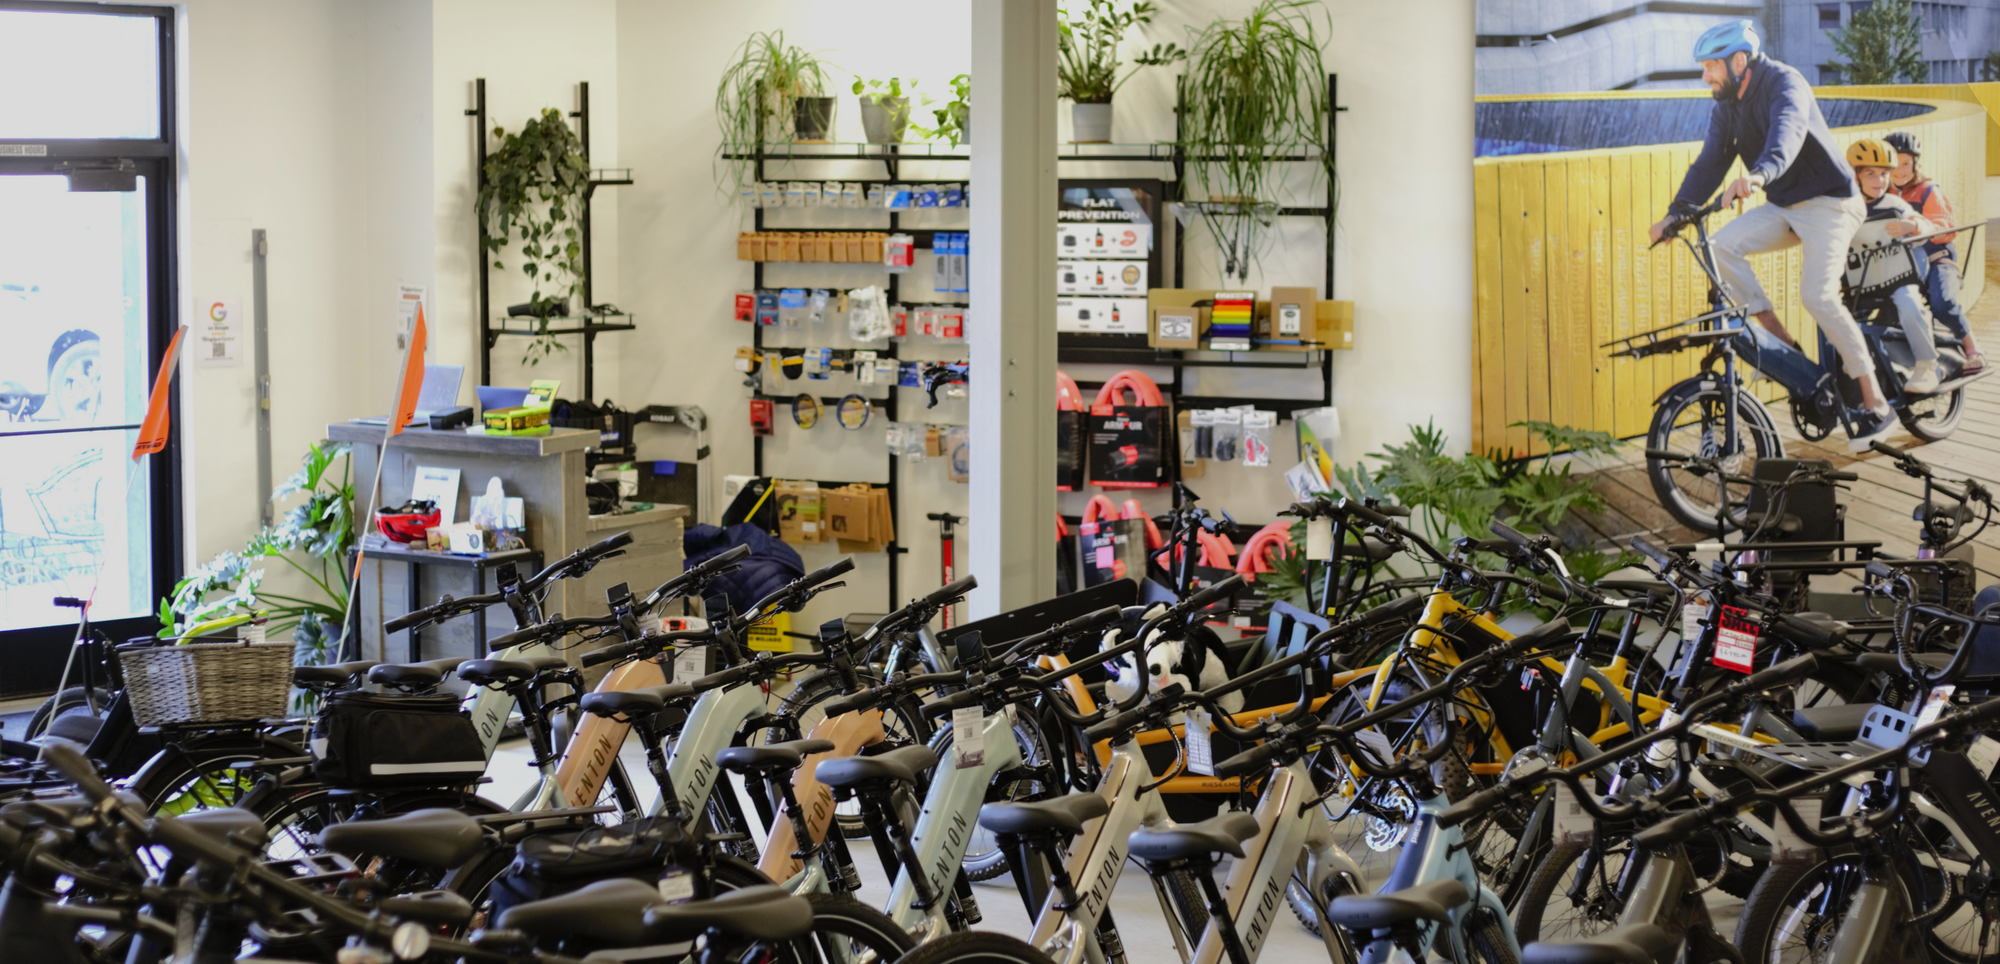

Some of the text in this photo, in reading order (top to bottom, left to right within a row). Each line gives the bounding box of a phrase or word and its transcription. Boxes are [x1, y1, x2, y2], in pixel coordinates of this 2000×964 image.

[1083, 199, 1115, 207] FLAT
[1058, 210, 1139, 220] PREVENTION
[650, 414, 675, 422] KOBALT
[1410, 819, 1424, 844] pace
[1086, 844, 1120, 918] ENTON
[1246, 875, 1280, 953] ENTON
